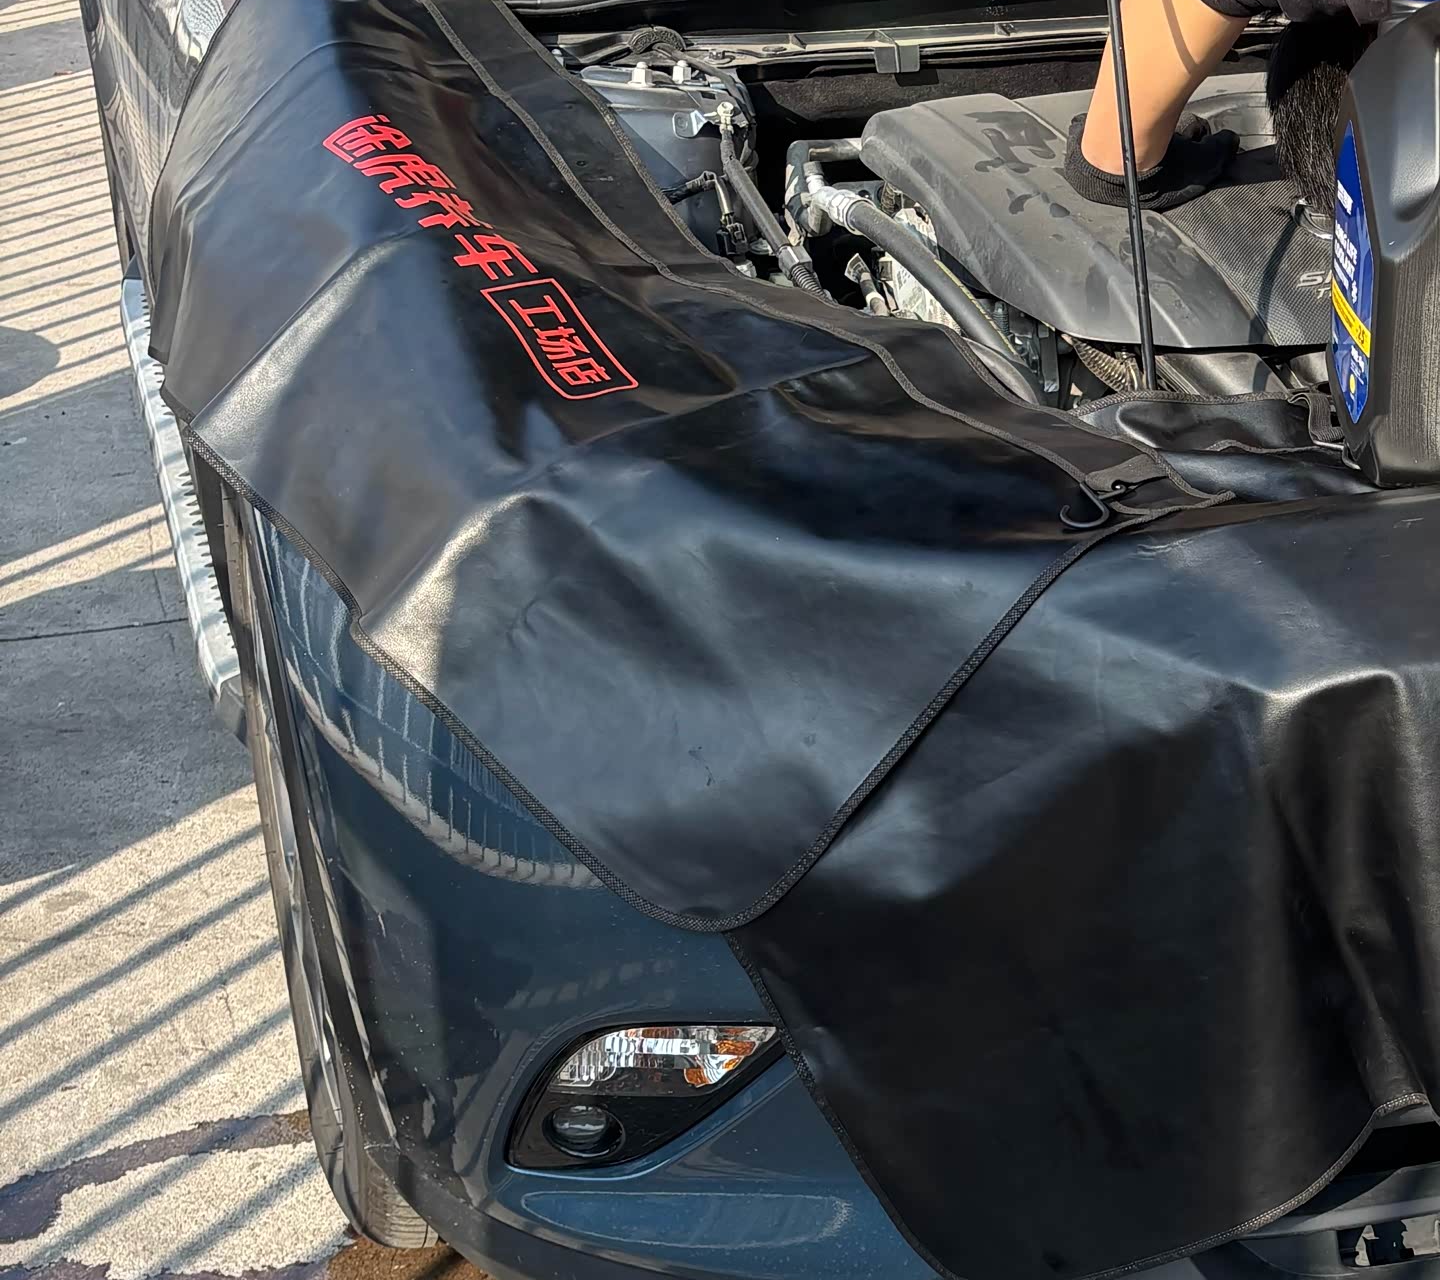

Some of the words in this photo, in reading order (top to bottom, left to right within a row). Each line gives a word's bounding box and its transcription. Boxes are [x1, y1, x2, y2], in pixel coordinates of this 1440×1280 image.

[322, 114, 539, 280] 途虎养车
[508, 294, 612, 387] 工场店
